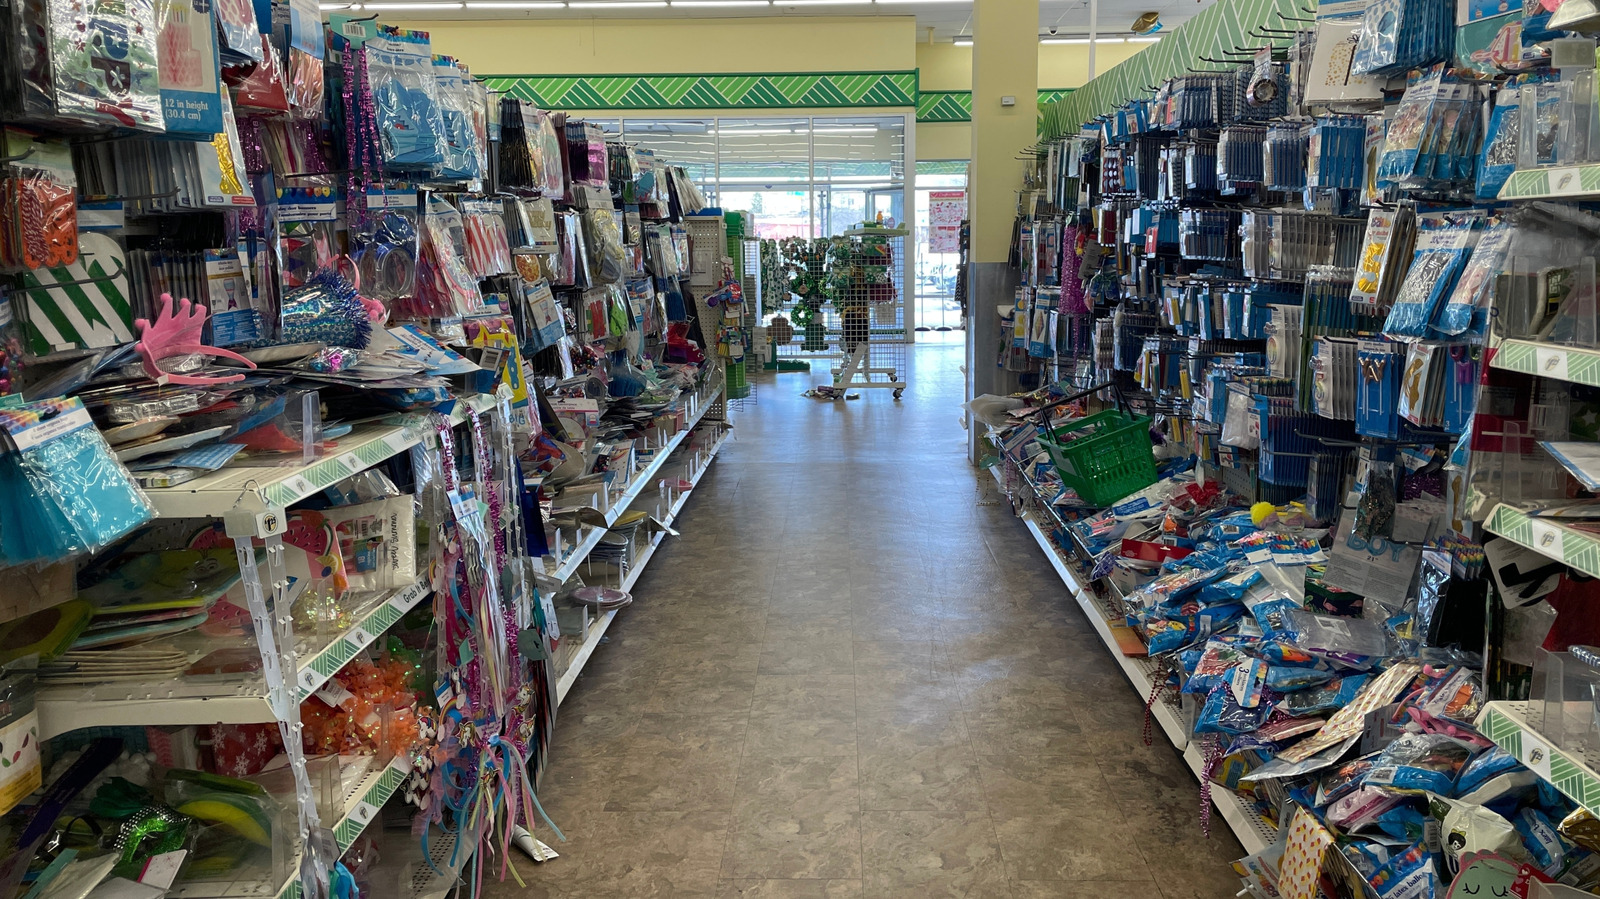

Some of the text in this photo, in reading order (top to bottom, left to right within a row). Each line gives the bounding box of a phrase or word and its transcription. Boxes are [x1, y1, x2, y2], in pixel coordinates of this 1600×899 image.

[165, 99, 208, 111] 12 in height
[165, 109, 201, 122] (30.4 cm)
[403, 587, 417, 603] Grab
[1238, 666, 1250, 674] 3
[1393, 884, 1409, 898] latex
